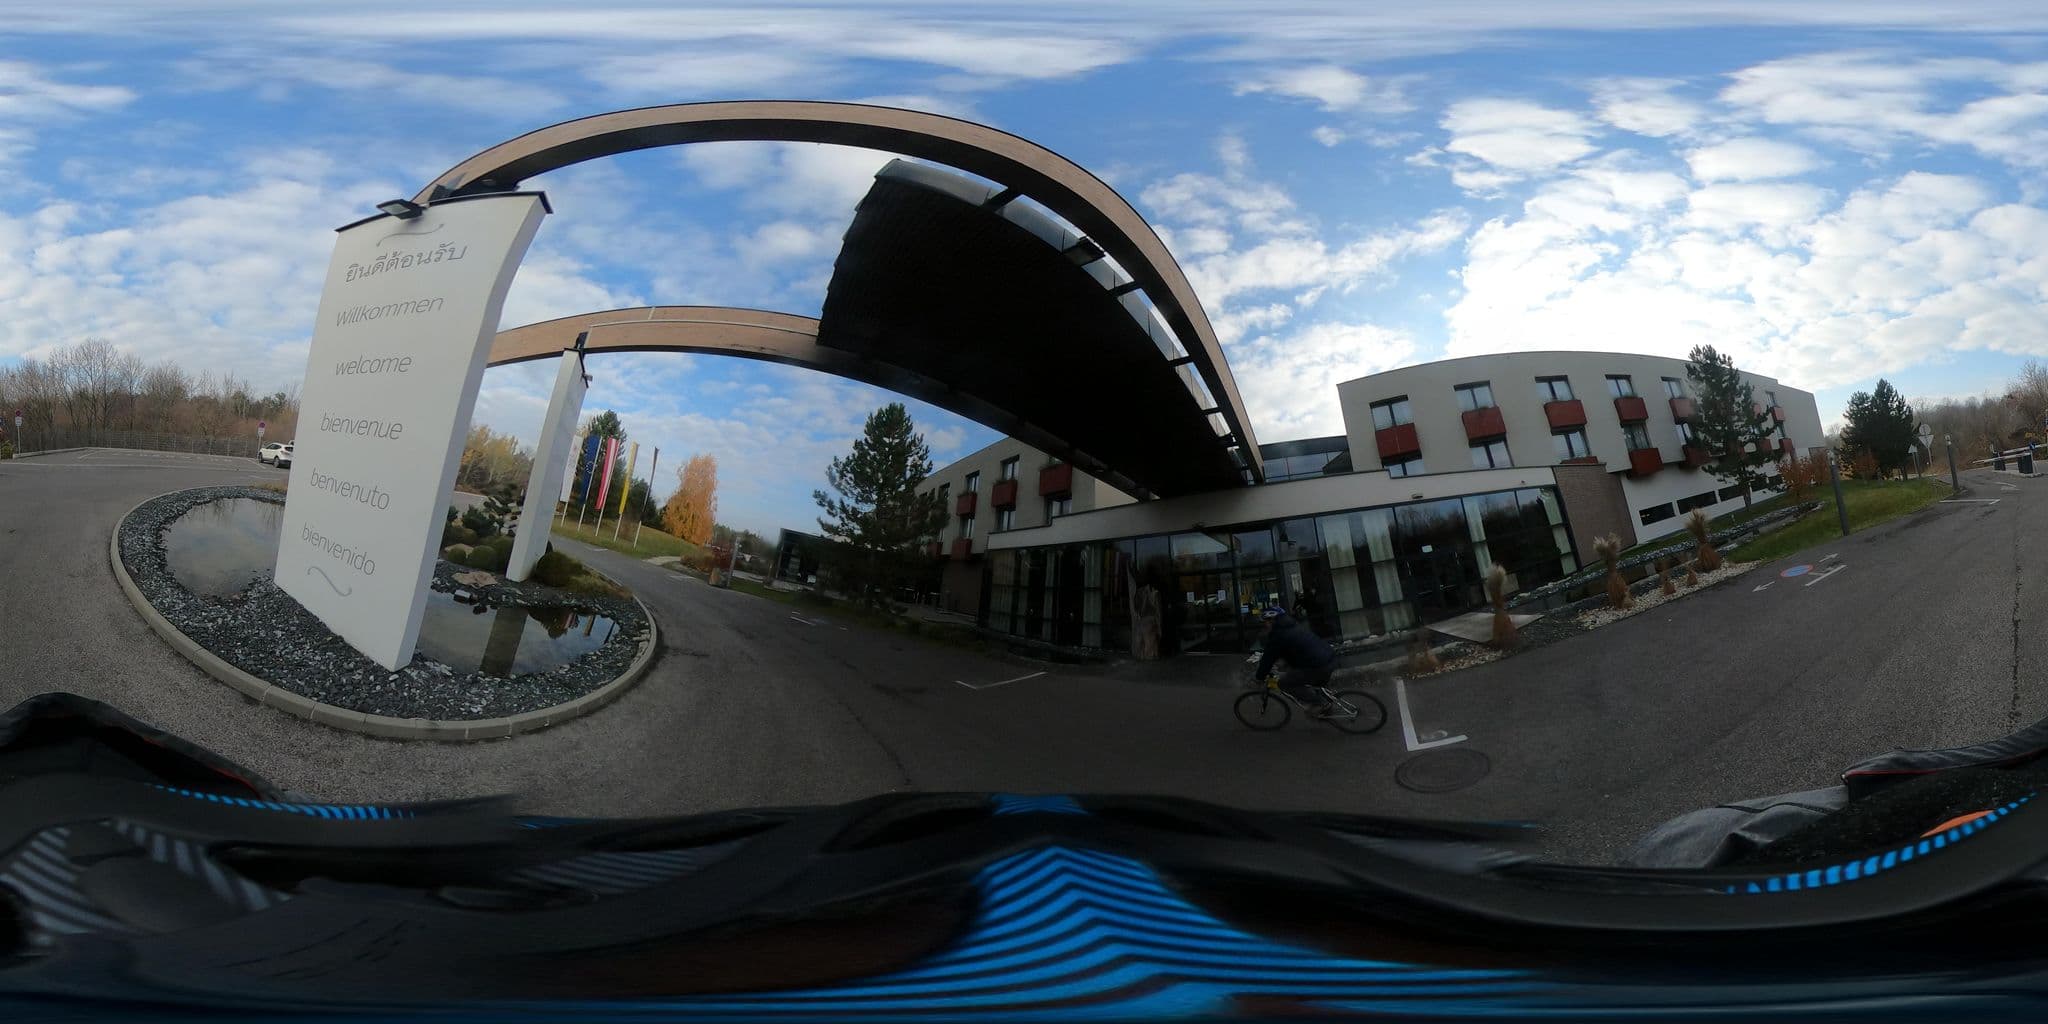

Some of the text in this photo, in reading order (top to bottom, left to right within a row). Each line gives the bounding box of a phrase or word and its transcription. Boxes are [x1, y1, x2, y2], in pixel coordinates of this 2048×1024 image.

[345, 241, 467, 282] ยินดีต้อนรับ
[336, 296, 444, 327] willkommen
[335, 354, 412, 376] welcome
[320, 412, 403, 440] bienvenue
[310, 468, 390, 510] benvenuto
[302, 523, 376, 576] bienvenido
